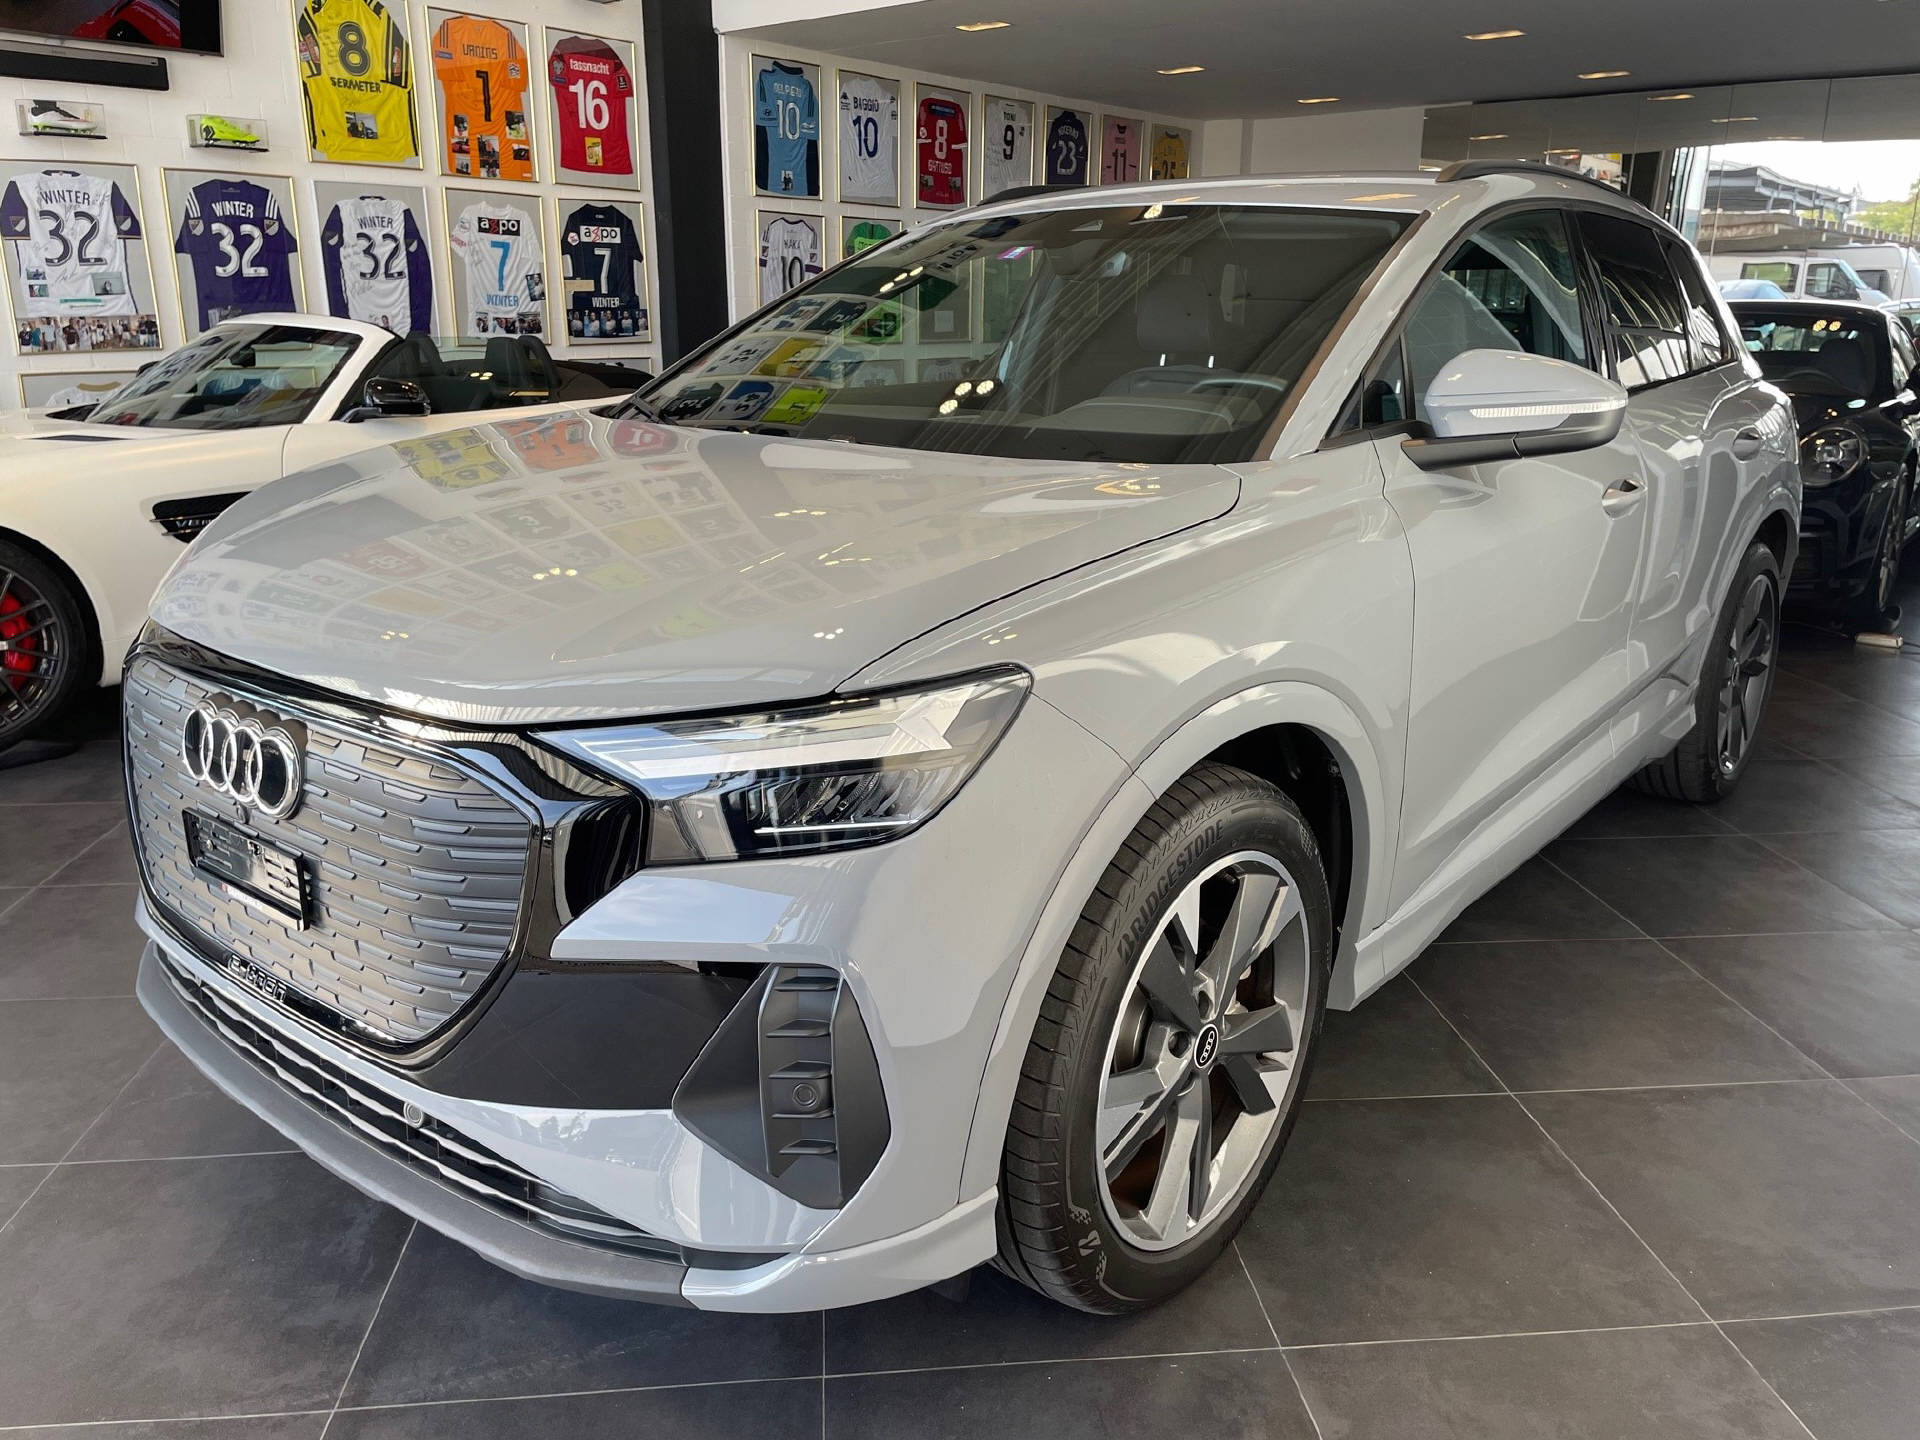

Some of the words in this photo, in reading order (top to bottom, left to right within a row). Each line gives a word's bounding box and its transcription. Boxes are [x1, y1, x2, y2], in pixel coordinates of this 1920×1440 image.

[338, 21, 371, 77] 8
[475, 69, 492, 122] 1
[568, 78, 610, 131] 16
[776, 99, 801, 140] 10
[853, 115, 879, 158] 10
[934, 119, 948, 160] 8
[1003, 124, 1015, 160] 9
[40, 189, 91, 206] WINTER
[211, 200, 255, 219] WINTER
[39, 209, 108, 267] 32
[357, 215, 394, 230] WINTER
[210, 222, 270, 278] 32
[356, 232, 407, 280] 32
[490, 239, 511, 292] 7
[593, 247, 612, 295] 7
[486, 293, 519, 307] WINTER
[591, 297, 620, 309] WINTER
[1117, 820, 1223, 963] BRIDGESTONE
